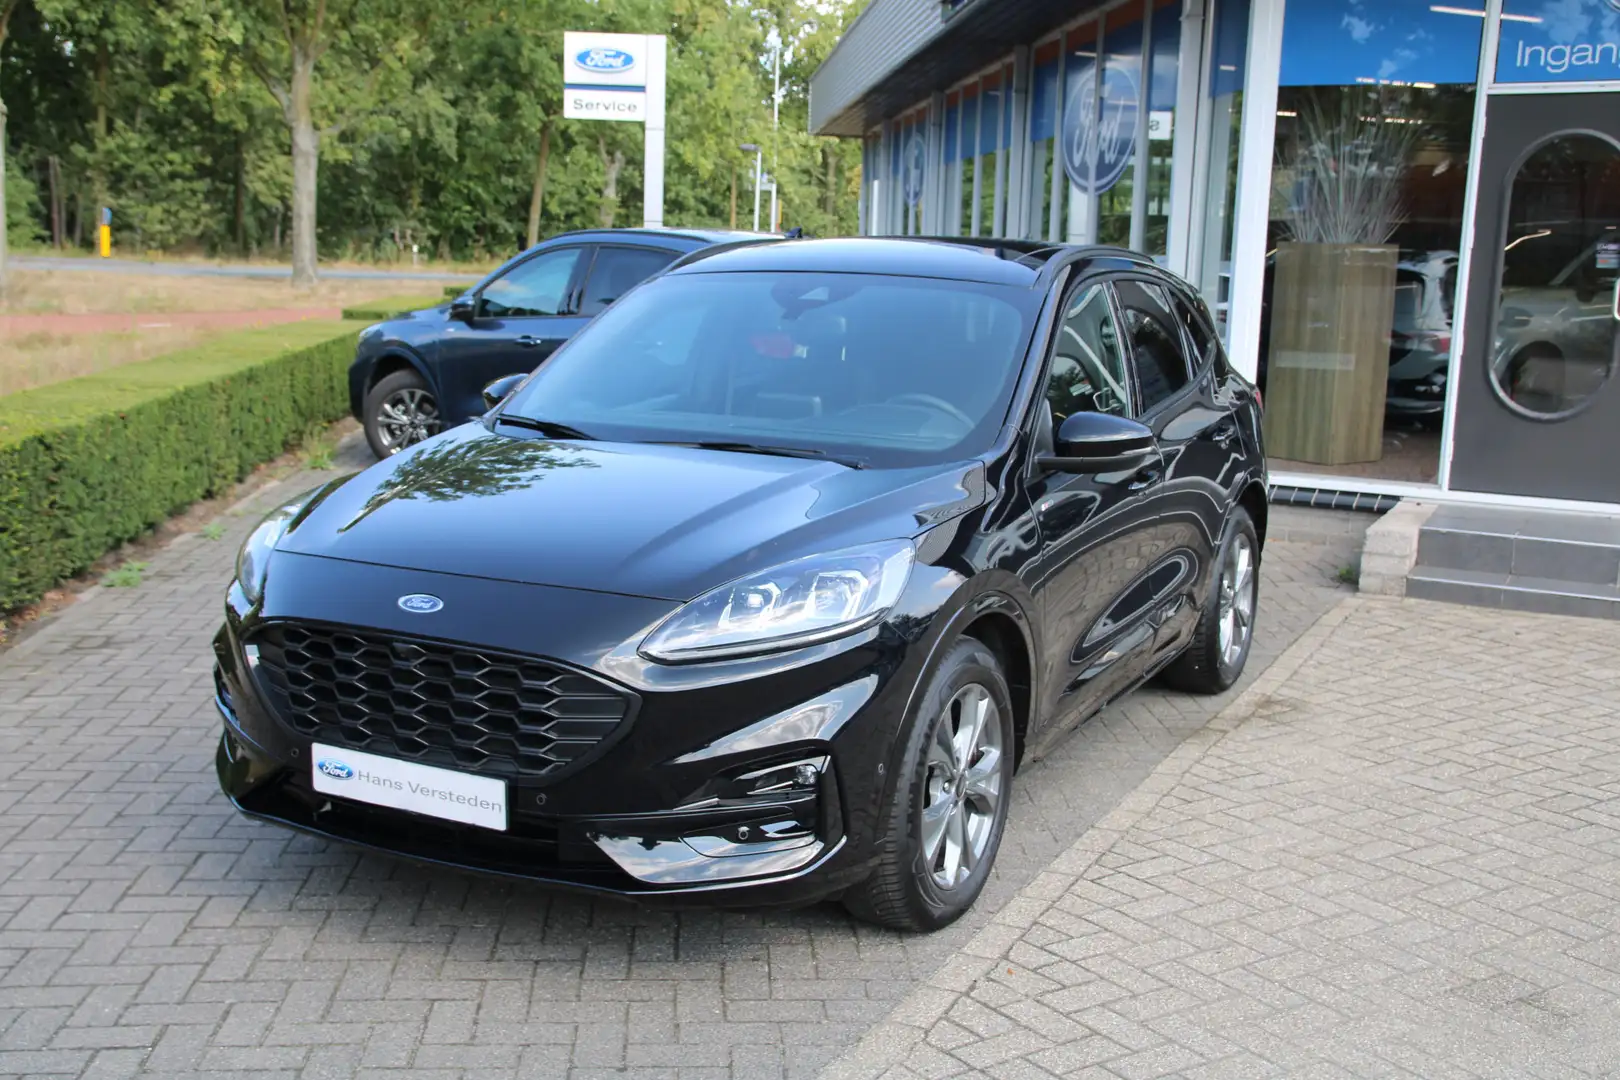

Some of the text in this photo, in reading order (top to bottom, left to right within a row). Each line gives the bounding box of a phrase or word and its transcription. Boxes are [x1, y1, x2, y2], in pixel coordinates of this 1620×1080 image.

[586, 49, 625, 67] Ford
[1516, 40, 1620, 73] Ingan
[573, 98, 637, 111] Service
[322, 760, 502, 812] Ford Hans Versteden
